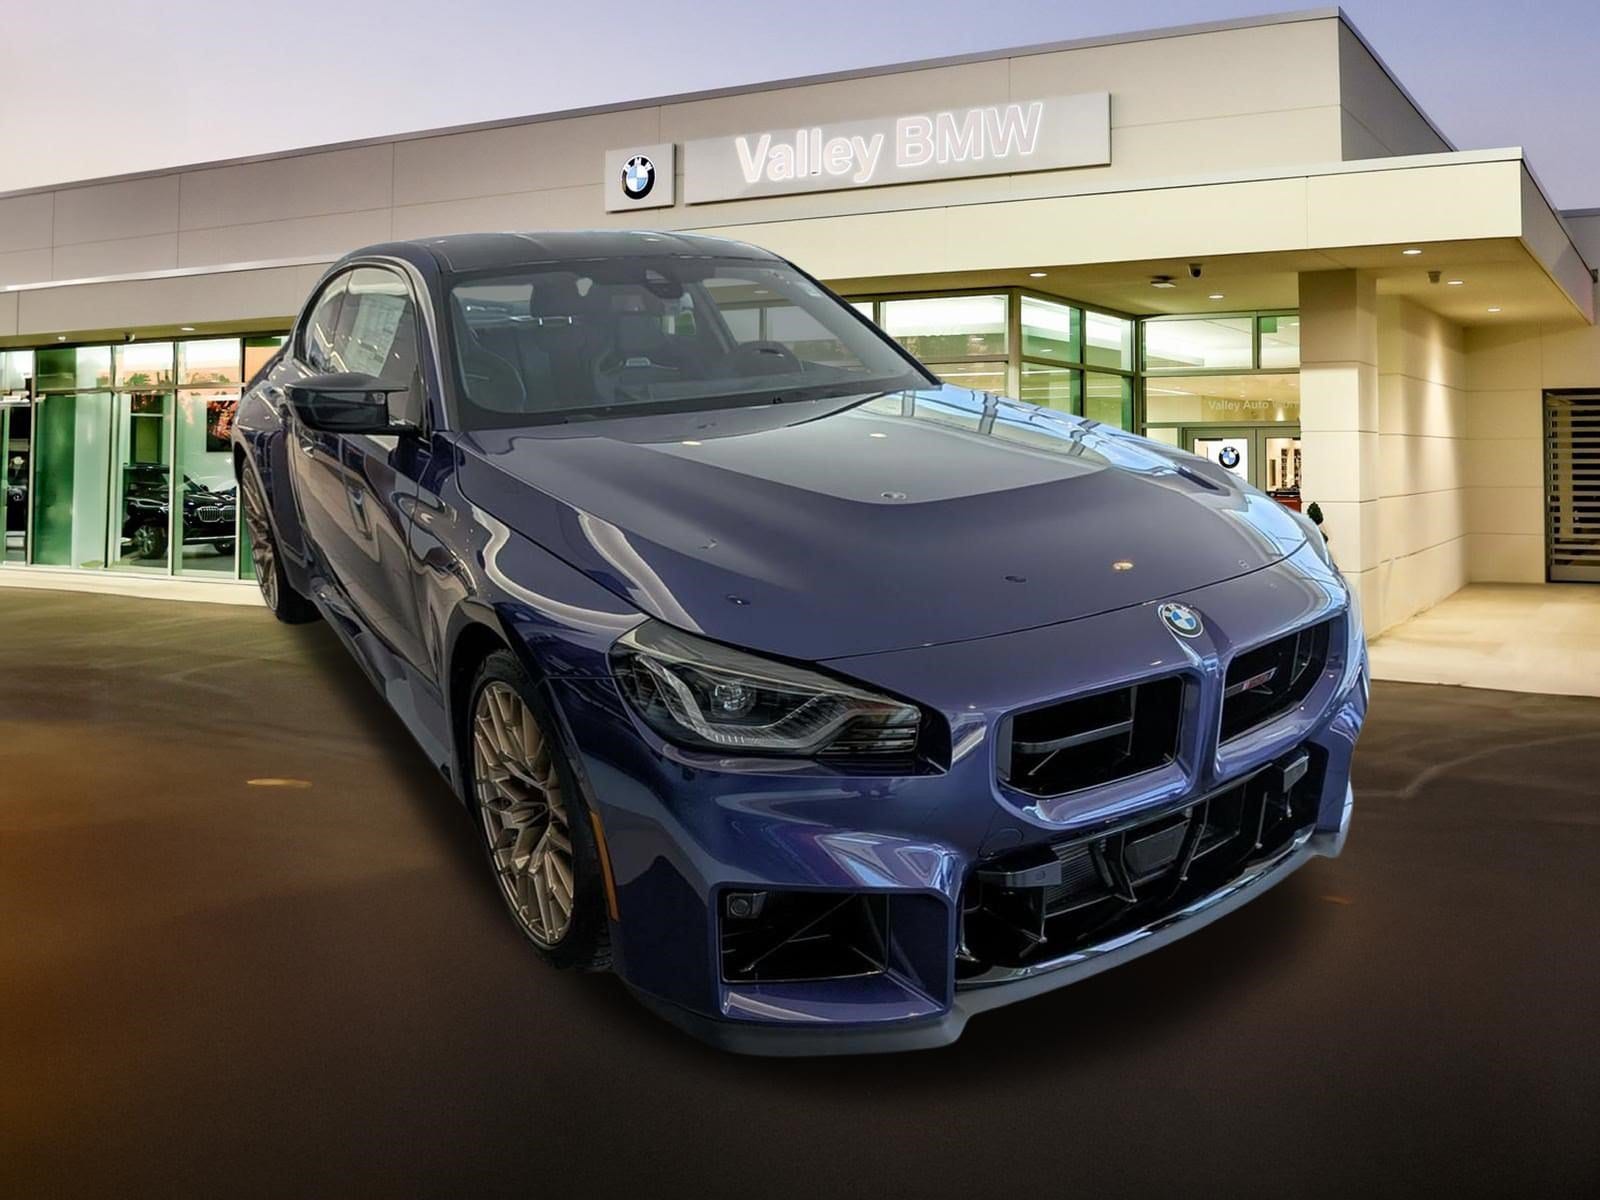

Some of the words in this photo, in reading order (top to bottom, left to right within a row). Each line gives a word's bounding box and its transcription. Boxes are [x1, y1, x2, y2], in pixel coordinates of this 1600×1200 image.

[735, 128, 884, 183] Valley
[896, 102, 1043, 167] BMW
[1208, 400, 1240, 411] Valley
[1242, 400, 1269, 409] Auto
